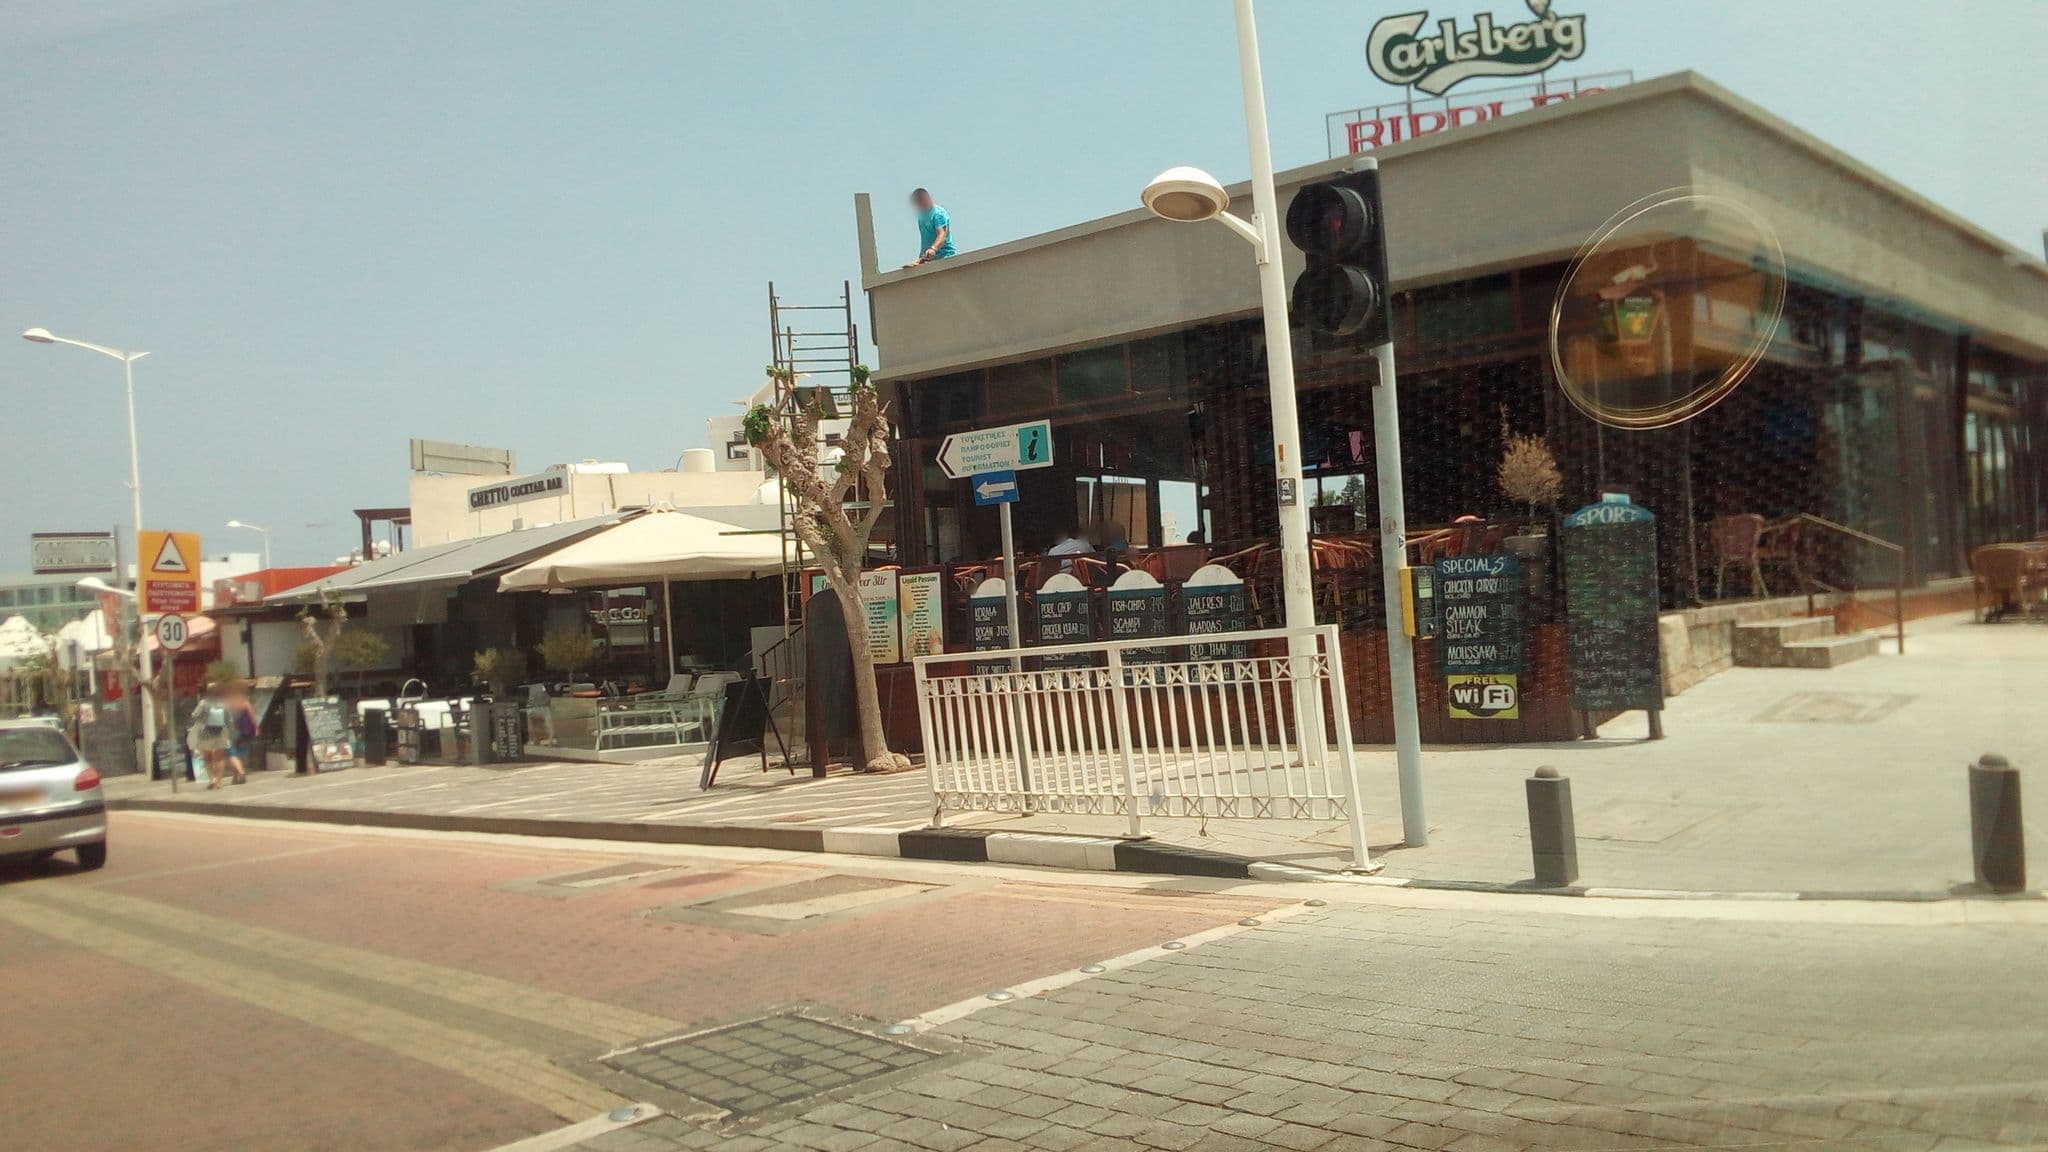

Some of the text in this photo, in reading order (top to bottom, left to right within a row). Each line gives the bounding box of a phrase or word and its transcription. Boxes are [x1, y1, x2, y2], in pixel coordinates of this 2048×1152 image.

[1366, 10, 1586, 87] Carlsberg
[961, 453, 992, 463] TOURIST
[470, 477, 563, 508] GHETTO COCKTAIL BAR
[1442, 556, 1504, 574] SPECIALS
[163, 621, 182, 641] 30
[1189, 619, 1222, 633] MADRAS
[1446, 620, 1486, 634] STEAK
[1448, 645, 1497, 661] MOUSSAKA
[1466, 676, 1497, 685] FREE
